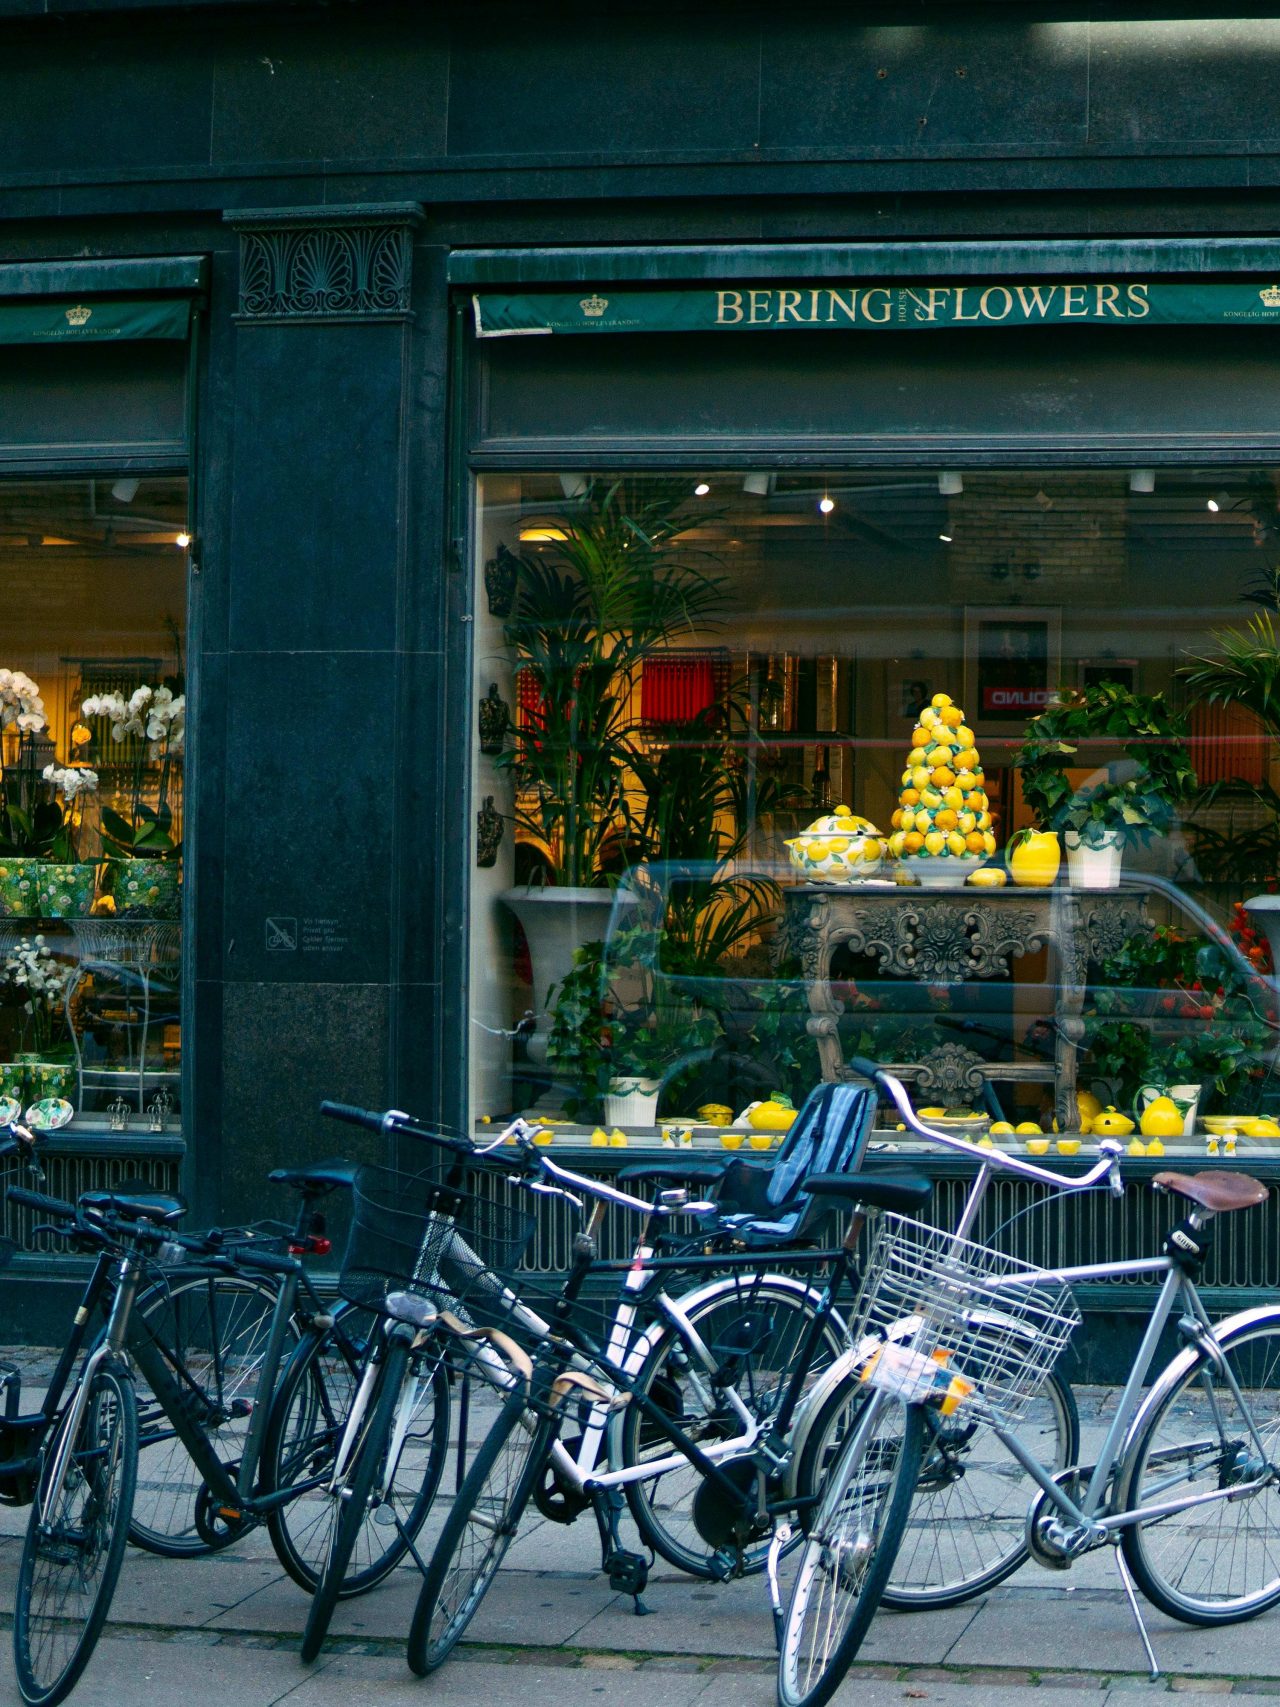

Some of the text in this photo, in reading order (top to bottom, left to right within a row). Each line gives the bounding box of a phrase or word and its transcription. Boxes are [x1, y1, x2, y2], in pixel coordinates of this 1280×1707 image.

[714, 288, 894, 324] BERING
[898, 288, 907, 322] HOUSE
[925, 284, 1150, 321] FLOWERS
